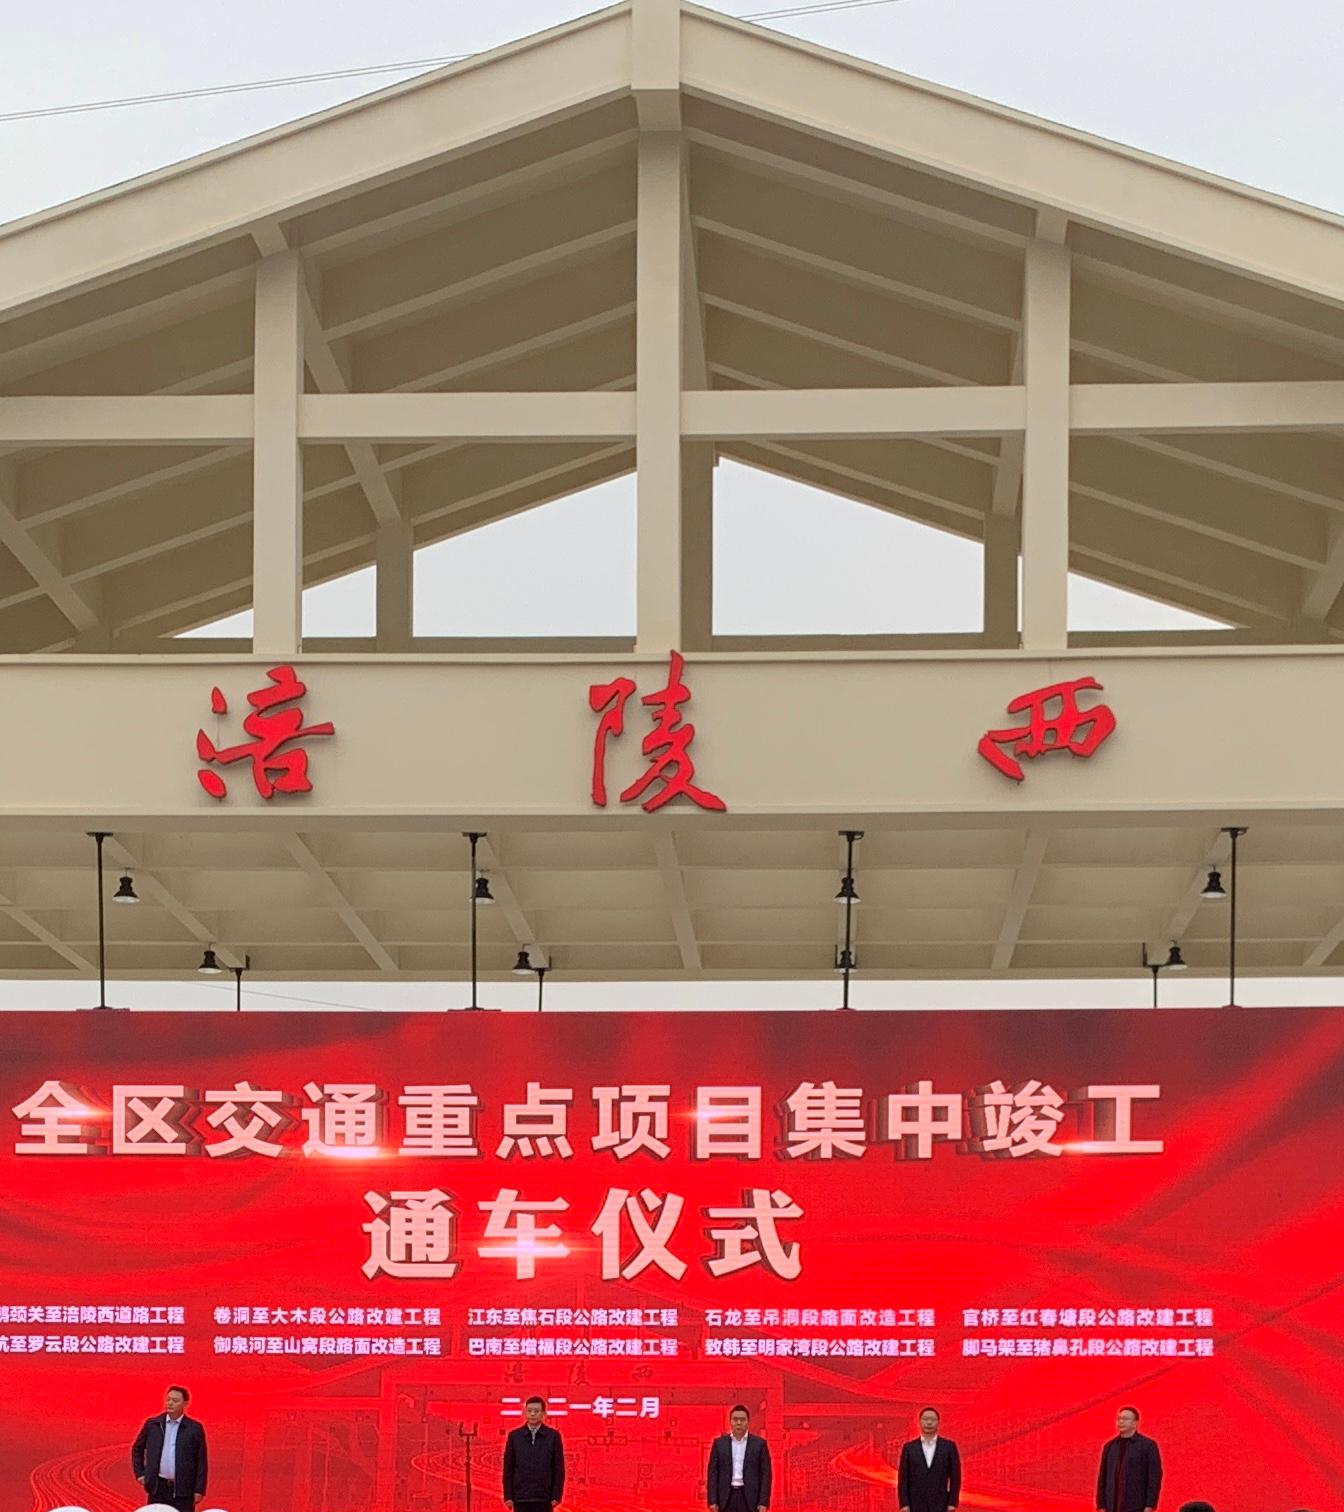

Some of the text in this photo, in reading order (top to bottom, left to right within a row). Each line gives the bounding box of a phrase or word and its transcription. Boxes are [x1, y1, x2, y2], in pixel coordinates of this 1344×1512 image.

[196, 651, 1117, 811] 涪陵西
[11, 1080, 1165, 1160] 全区交通重点项目集中竣工
[361, 1188, 804, 1281] 通车仪式
[213, 1306, 441, 1326] 卷洞至大木段公路改建工程
[468, 1308, 678, 1327] 江东至焦石段公路改建工程
[705, 1308, 935, 1327] 石龙至吊洞段路面改造工程
[468, 1337, 678, 1356] 巴南至增福段公路改建工程
[500, 1395, 660, 1418] 二二一年二月
